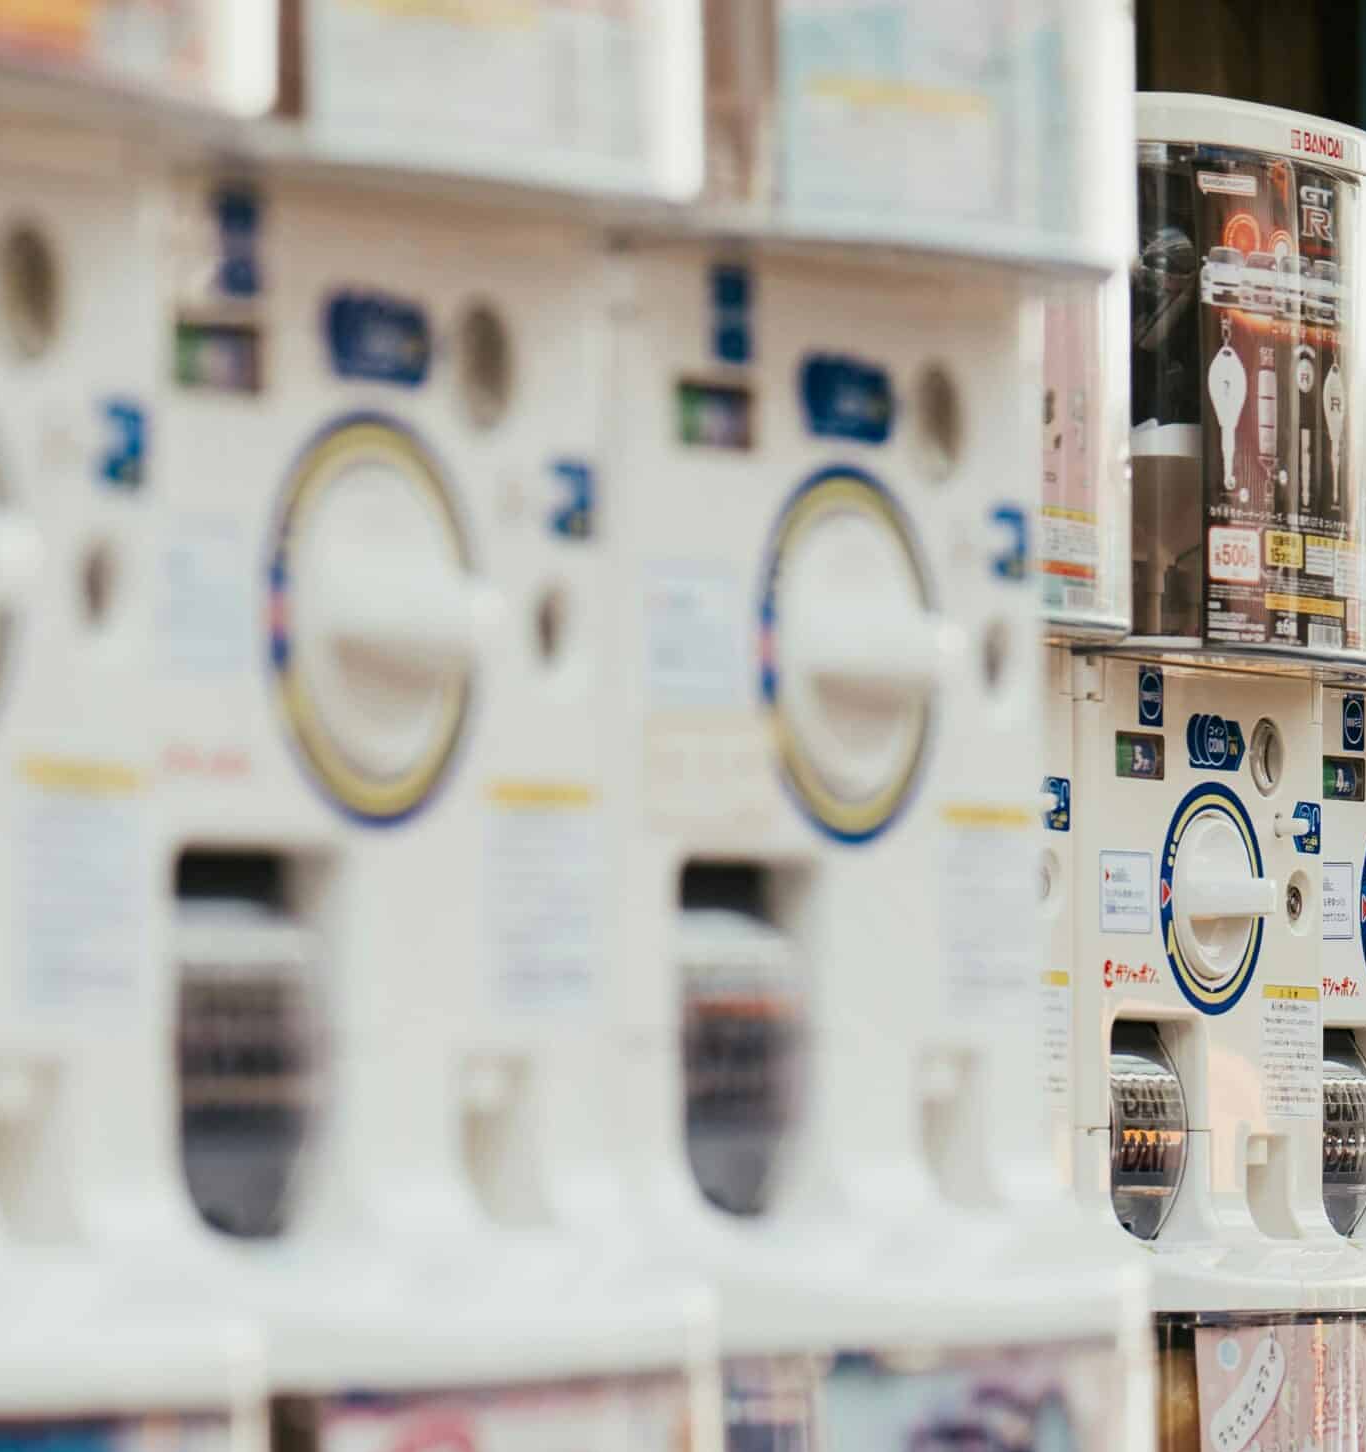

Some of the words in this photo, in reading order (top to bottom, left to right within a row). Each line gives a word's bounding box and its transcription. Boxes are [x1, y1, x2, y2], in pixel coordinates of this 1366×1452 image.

[1304, 131, 1343, 160] BANDAI
[1300, 204, 1333, 242] R
[1208, 738, 1225, 753] COIN
[1115, 963, 1157, 985] ガシャポン
